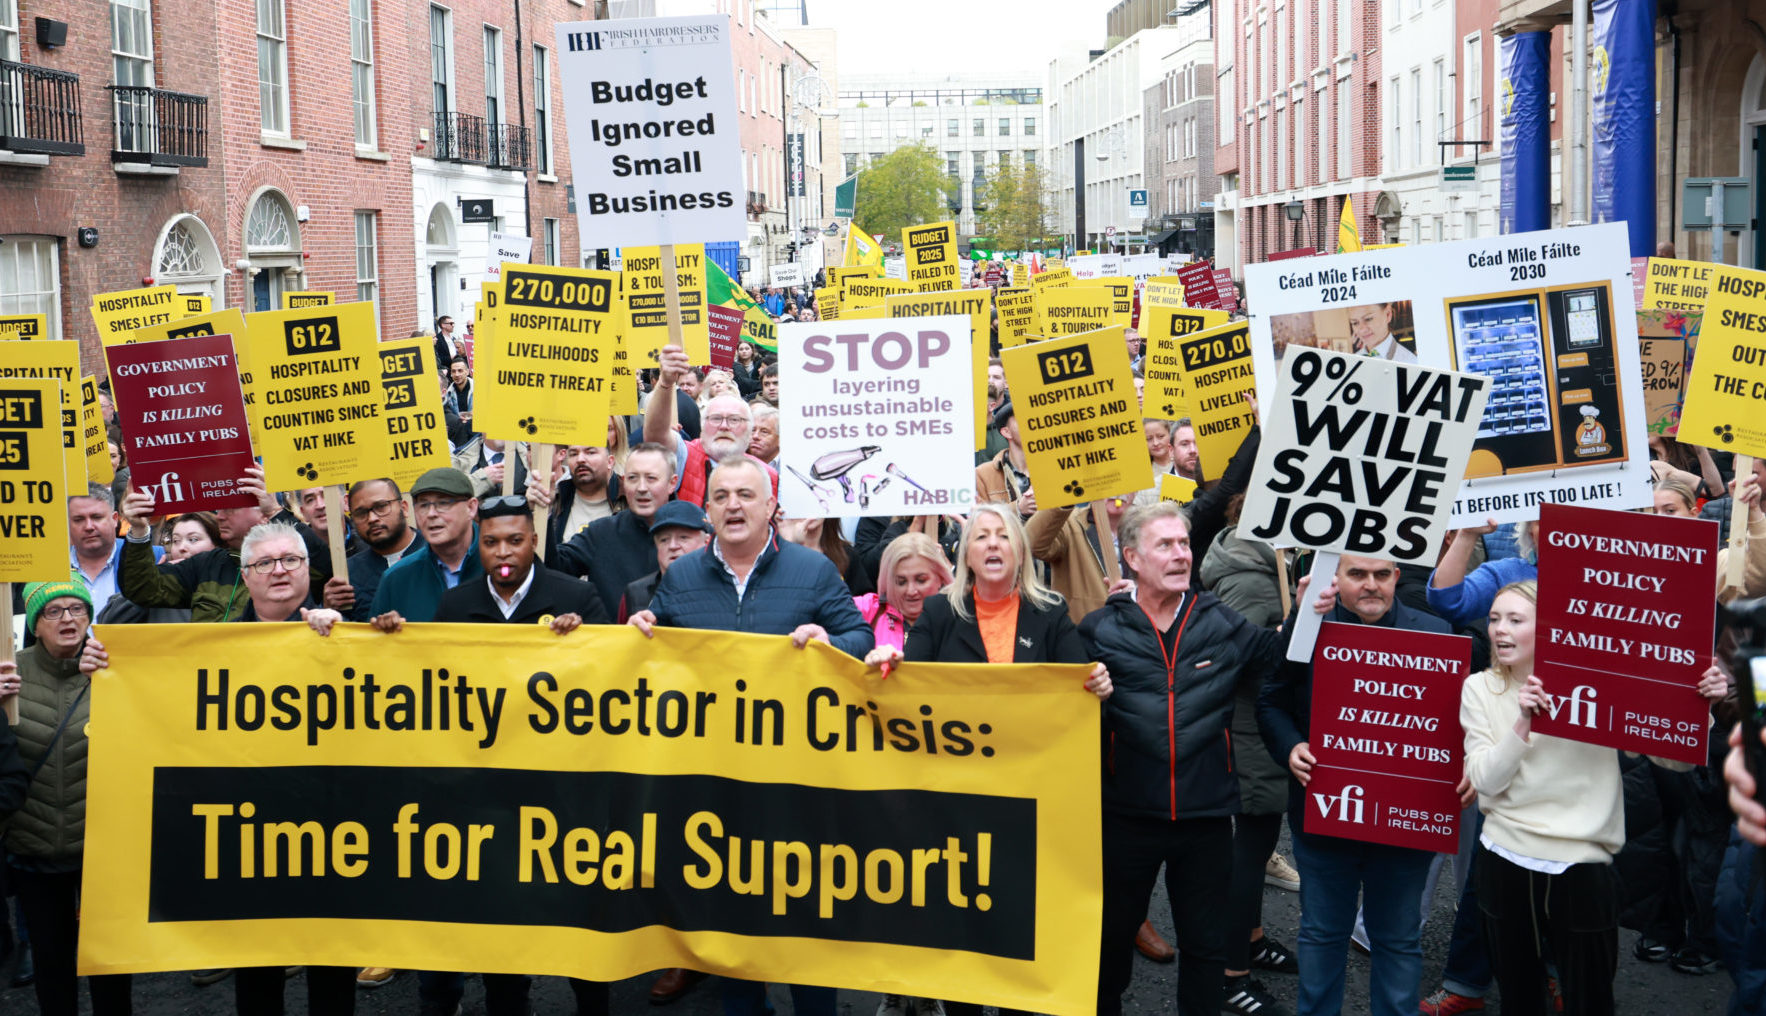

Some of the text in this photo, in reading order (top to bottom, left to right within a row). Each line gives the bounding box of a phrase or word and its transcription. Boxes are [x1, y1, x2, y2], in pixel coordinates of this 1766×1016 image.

[568, 31, 609, 51] IHF
[610, 25, 720, 39] IRISH HAIRDRESSERS
[610, 35, 720, 47] FEDERATION
[591, 76, 708, 106] Budget
[591, 113, 715, 147] Ignored
[612, 150, 702, 177] Small
[588, 189, 734, 215] Business
[911, 230, 946, 246] BUDGET
[498, 249, 520, 259] Save
[627, 254, 699, 272] HOSPILITY
[919, 250, 943, 262] 2025
[1468, 241, 1581, 268] Céad Míle Fáilte
[911, 265, 955, 281] FAILED TO
[1035, 271, 1070, 284] HOSPITALITY
[1279, 264, 1391, 290] Céad Míle Fáilte
[1510, 264, 1547, 281] 2030
[1652, 263, 1690, 279] DON'T
[510, 278, 606, 307] 270,000
[631, 275, 697, 290] & TOUSM:
[1147, 285, 1182, 296] DON'T LET
[1654, 281, 1679, 297] THE
[99, 290, 173, 313] HOSPITALITY
[292, 297, 327, 308] BUDGET
[998, 295, 1033, 307] DON'T LET
[1148, 294, 1178, 305] THE HIGH
[1321, 285, 1357, 303] 2024
[109, 312, 170, 333] SMES LEFT
[1002, 306, 1033, 318] THE HIGH
[1005, 317, 1031, 327] STREET
[1048, 306, 1109, 319] HOSPITALITY
[510, 313, 602, 335] HOSPITALITY
[1051, 322, 1059, 333] &
[1173, 317, 1200, 334] 612
[291, 323, 334, 349] 612
[507, 341, 599, 364] LIVELIHOODS
[802, 330, 951, 374] STOP
[116, 354, 229, 377] GOVERNMENT
[271, 356, 360, 380] HOSPITALITY
[1045, 351, 1087, 378] 612
[1661, 360, 1681, 377] 9%
[148, 381, 207, 399] POLICY
[266, 380, 371, 405] CLOSURES AND
[498, 370, 605, 393] UNDER THREAT
[833, 376, 920, 397] layering
[1163, 387, 1179, 397] VAT
[1291, 351, 1485, 423] 9% VAT
[1713, 374, 1748, 397] THE
[1028, 378, 1114, 408] HOSPITALITY
[142, 404, 224, 424] IS KILLING
[263, 403, 379, 430] COUNTING SINCE
[801, 397, 953, 418] unsustainable
[1027, 399, 1127, 431] CLOSURES AND
[413, 411, 437, 430] TO
[803, 419, 953, 440] costs to SMEs
[1199, 416, 1240, 437] UNDER
[135, 427, 239, 449] FAMILY PUBS
[293, 431, 355, 451] VAT HIKE
[1027, 420, 1137, 453] COUNTING SINCE
[1292, 399, 1449, 469] WILL
[390, 438, 433, 461] IVER
[1057, 447, 1117, 471] VAT HIKE
[23, 481, 54, 504] TO
[138, 472, 184, 503] vfi
[201, 479, 233, 489] PUBS
[1265, 448, 1447, 515] SAVE
[903, 488, 971, 506] HABIC
[1468, 495, 1520, 514] BEFORE
[1524, 493, 1545, 510] ITS
[1549, 487, 1577, 504] TOO
[1580, 484, 1614, 501] LATE
[1251, 496, 1432, 561] JOBS
[1547, 530, 1707, 565] GOVERNMENT
[1583, 567, 1667, 593] POLICY
[1567, 598, 1682, 630] IS KILLING
[1549, 628, 1696, 666] FAMILY PUBS
[1322, 645, 1462, 675] GOVERNMENT
[1353, 679, 1427, 700] POLICY
[196, 667, 996, 759] Hospitality Sector in Crisis:
[1546, 685, 1598, 729] vfi
[1337, 707, 1440, 733] IS KILLING
[1625, 712, 1701, 733] PUBS OF
[1624, 725, 1699, 748] IRELAND
[1322, 734, 1451, 764] FAMILY PUBS
[1312, 784, 1365, 824] vfi
[1388, 806, 1455, 823] PUBS OF
[1387, 818, 1453, 836] IRELAND
[192, 802, 993, 920] Time for Real Support!
